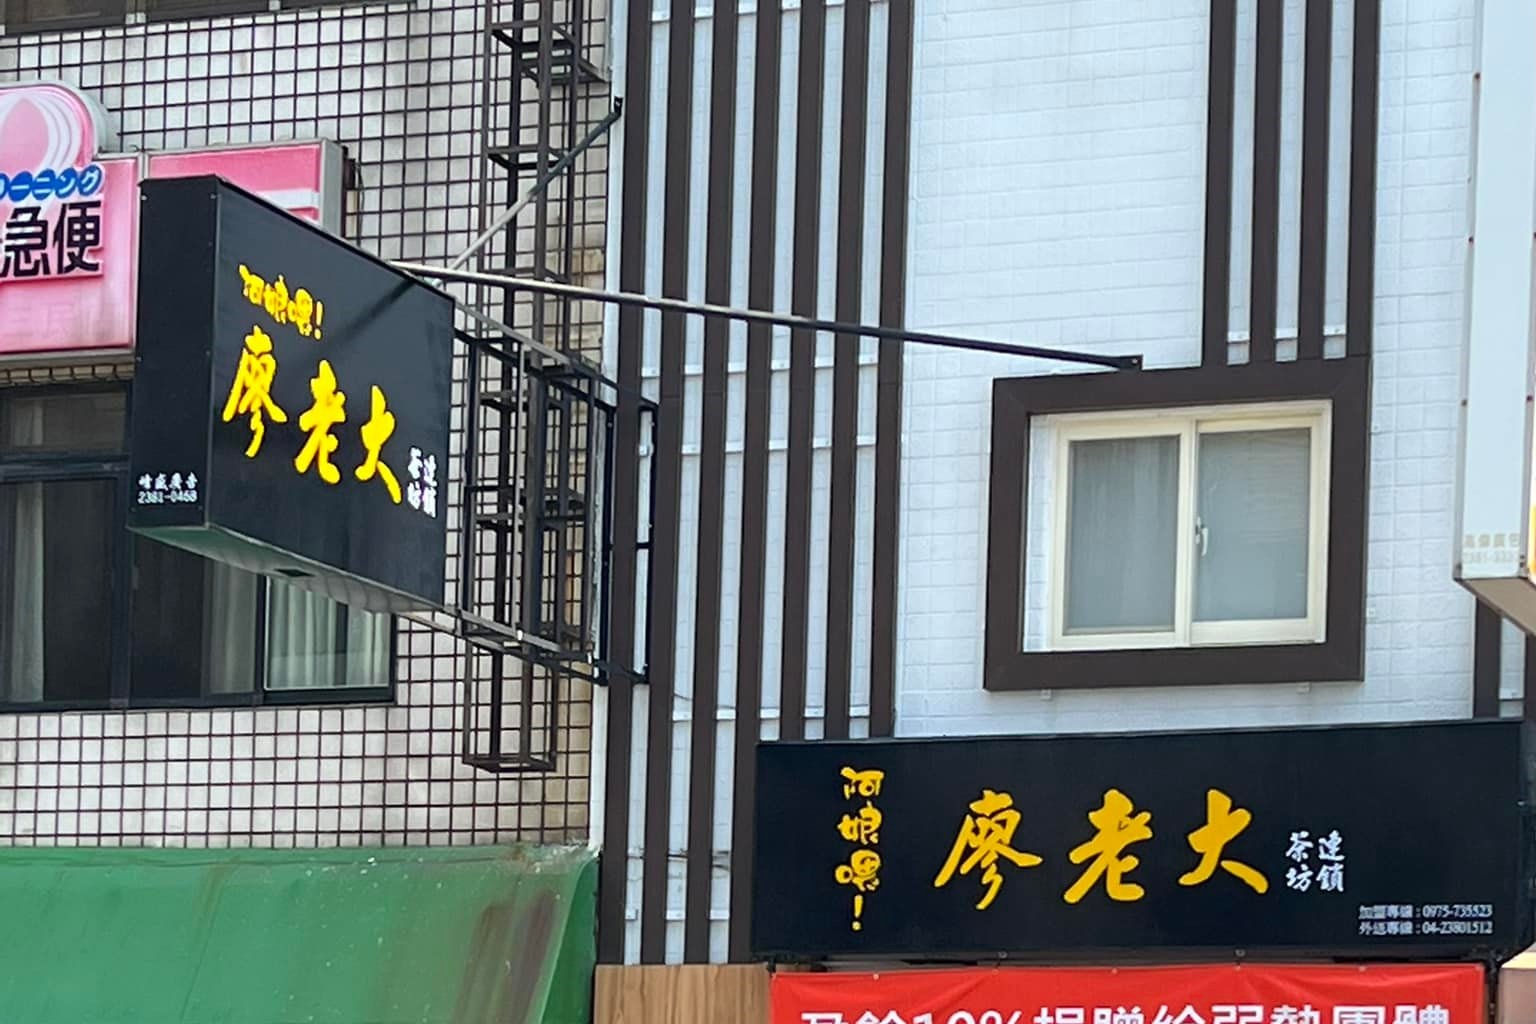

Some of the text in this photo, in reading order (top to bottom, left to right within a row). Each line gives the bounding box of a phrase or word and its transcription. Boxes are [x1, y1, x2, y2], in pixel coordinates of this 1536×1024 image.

[222, 325, 403, 504] 廖老大
[934, 789, 1269, 910] 廖老大
